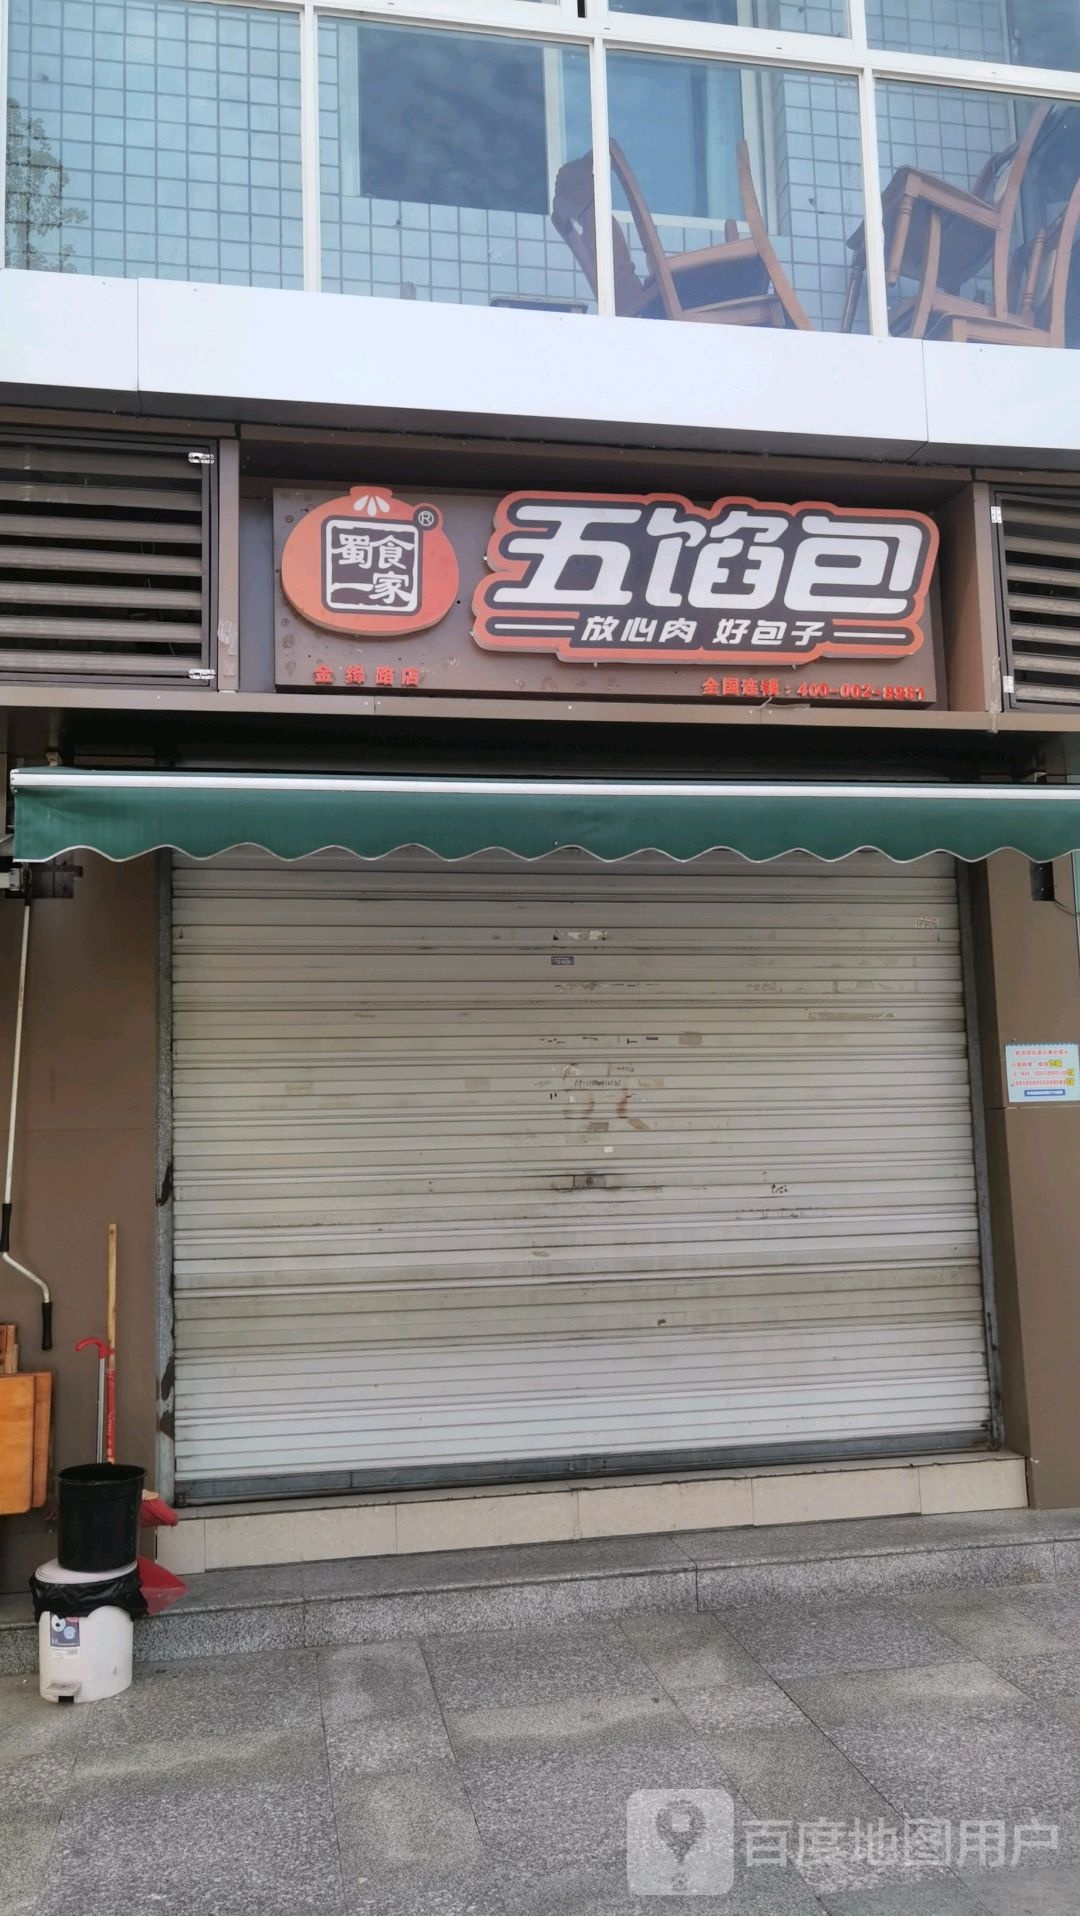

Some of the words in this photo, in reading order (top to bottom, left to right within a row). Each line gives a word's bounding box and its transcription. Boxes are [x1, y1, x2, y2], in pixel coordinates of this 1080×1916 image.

[494, 505, 921, 614] 五馅包
[581, 615, 696, 645] 放心肉
[712, 618, 825, 645] 好包子
